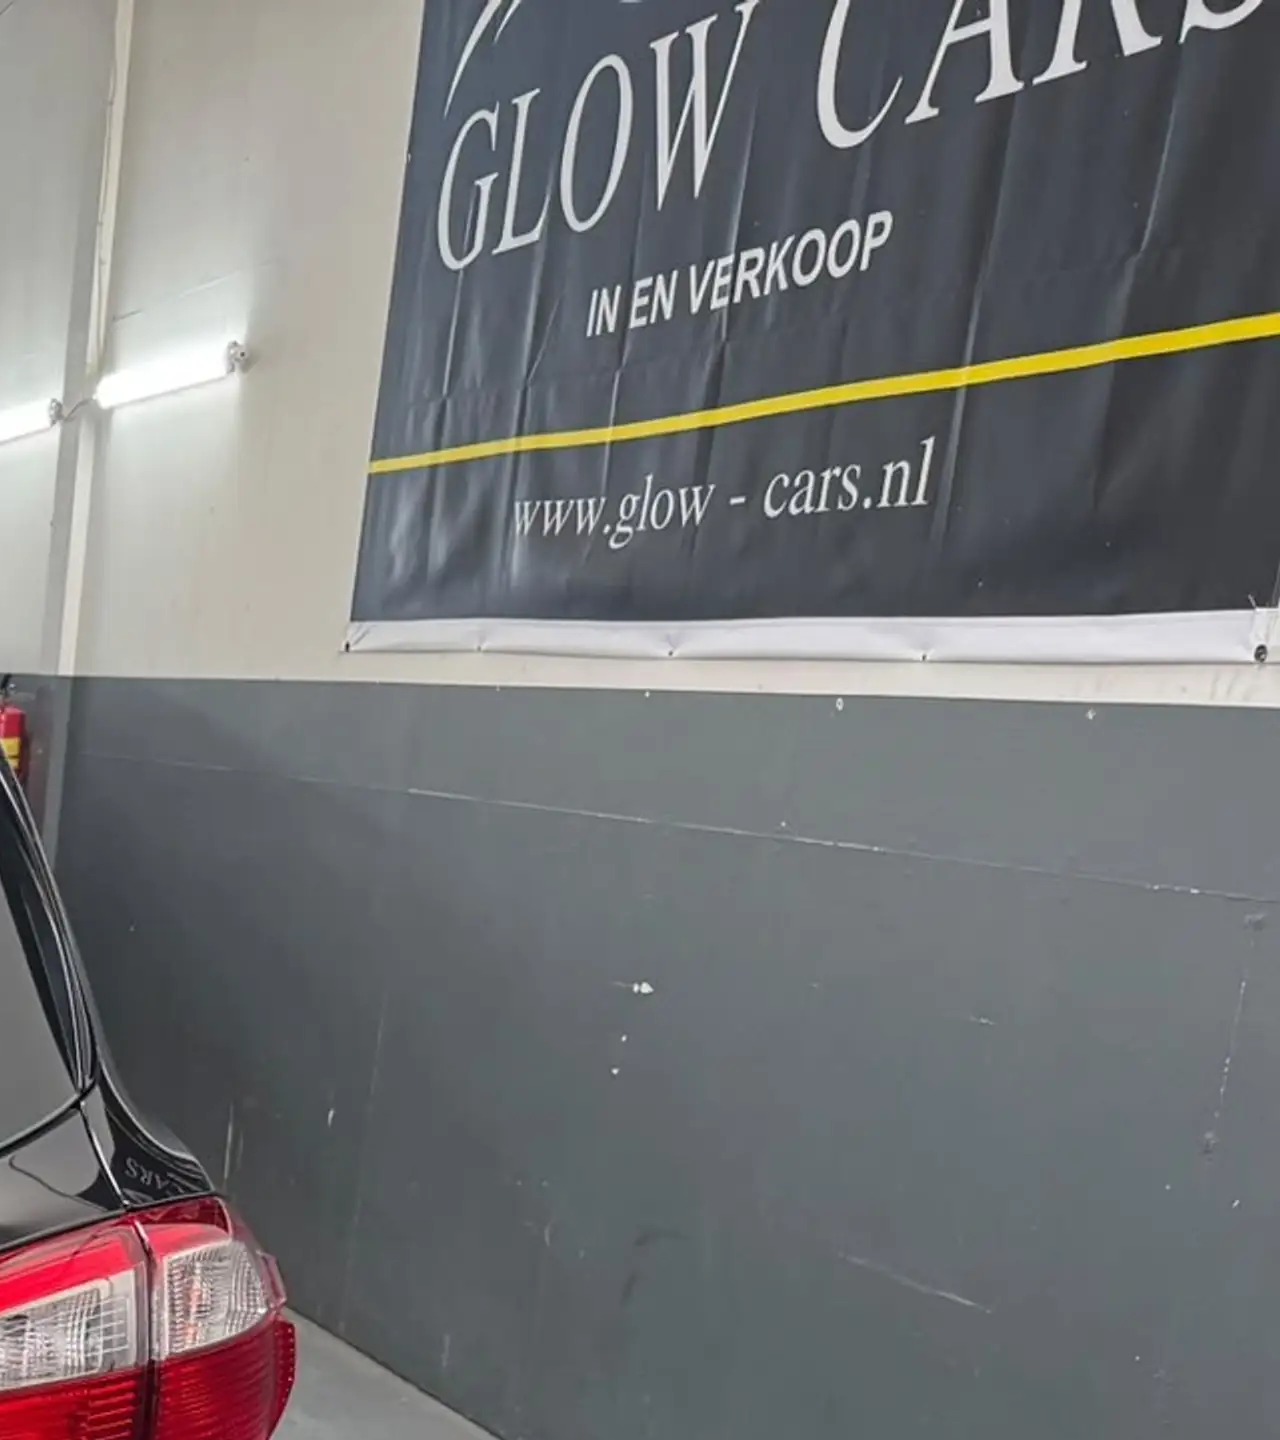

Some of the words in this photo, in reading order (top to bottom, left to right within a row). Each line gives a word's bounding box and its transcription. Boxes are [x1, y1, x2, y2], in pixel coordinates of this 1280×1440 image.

[437, 0, 760, 270] GLOW
[586, 285, 621, 337] IN
[629, 269, 678, 329] EN
[690, 210, 893, 315] VERKOOP
[513, 474, 717, 549] www.glow
[762, 435, 936, 520] cars.nl
